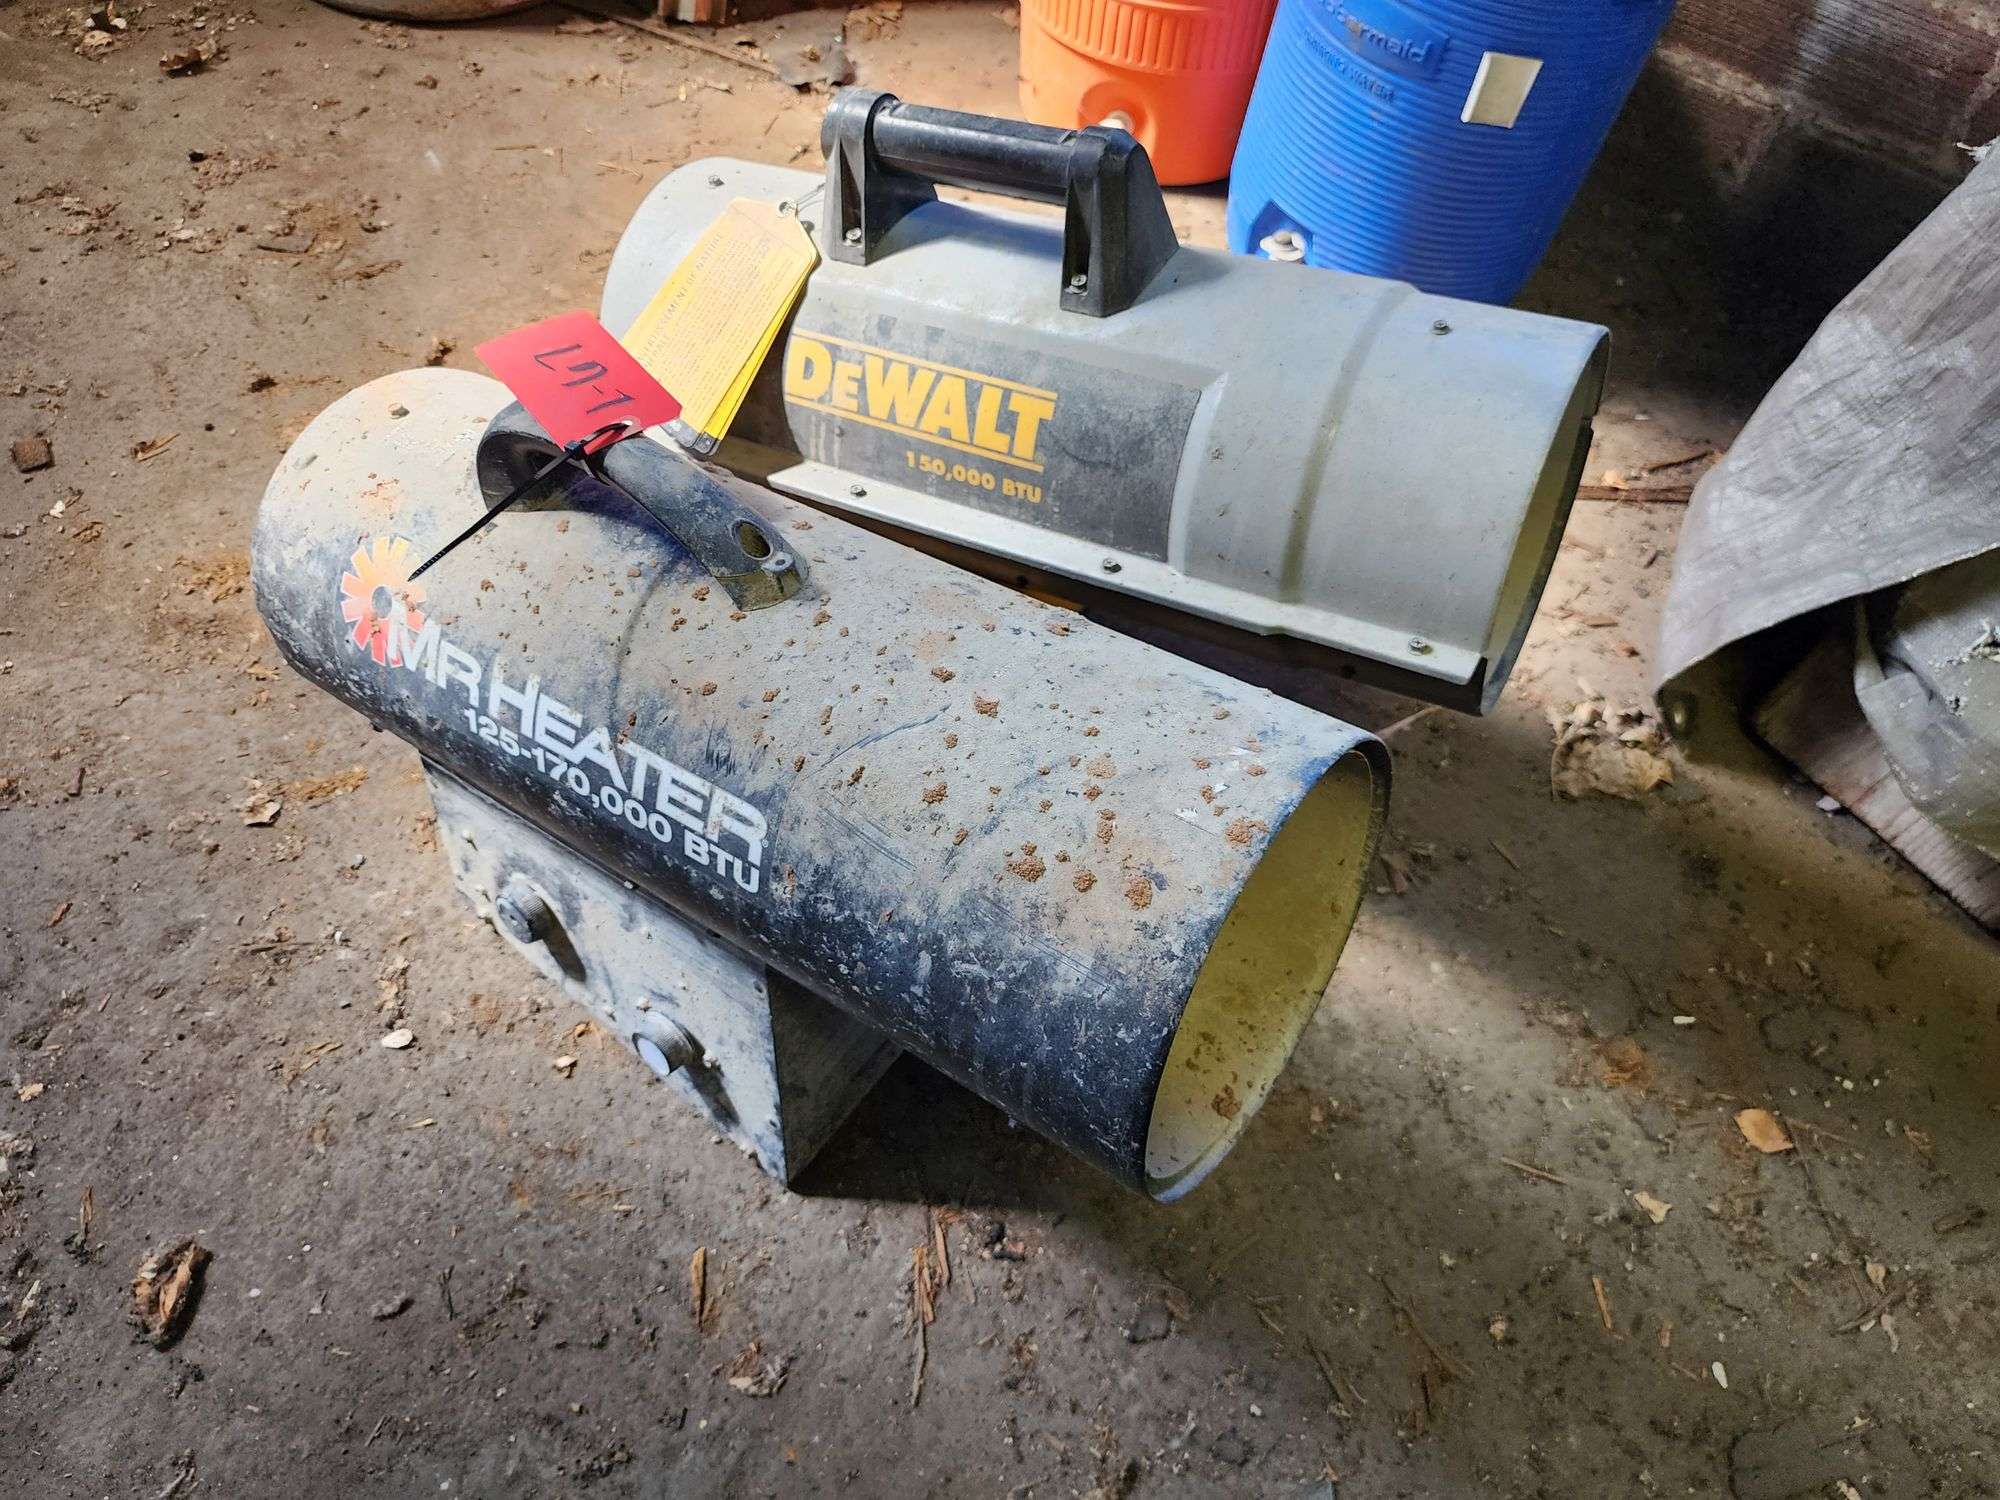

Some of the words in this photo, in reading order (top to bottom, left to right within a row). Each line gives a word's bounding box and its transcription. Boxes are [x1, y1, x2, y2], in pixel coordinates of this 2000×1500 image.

[905, 450, 996, 491] 150,000
[1002, 478, 1042, 504] BTU
[386, 601, 482, 708] MR
[487, 656, 769, 868] HEATER
[463, 708, 673, 844] 125-170,000
[683, 828, 760, 893] BTU
